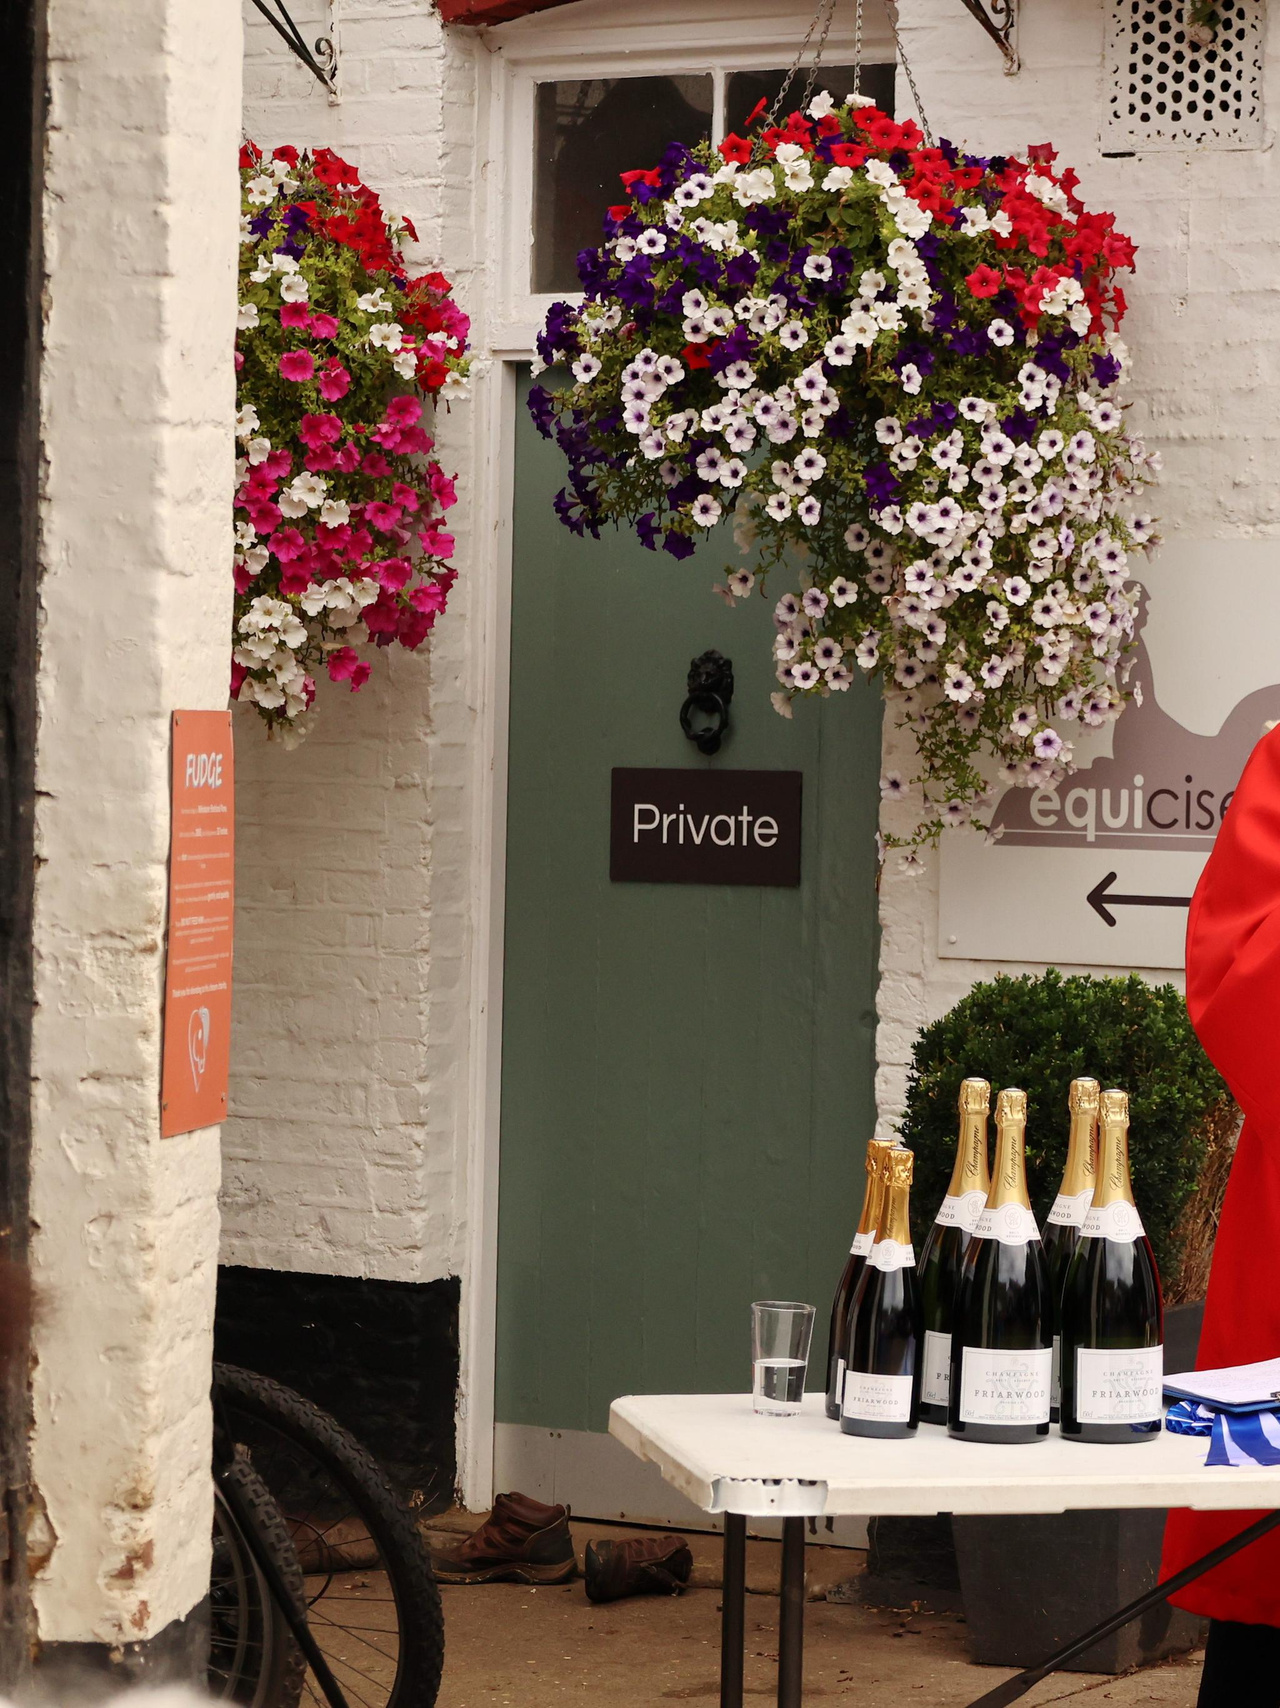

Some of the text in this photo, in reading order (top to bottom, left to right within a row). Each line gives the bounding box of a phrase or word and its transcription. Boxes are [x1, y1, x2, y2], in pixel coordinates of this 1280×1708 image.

[184, 751, 223, 789] FUDGE
[633, 803, 779, 848] Private
[965, 1124, 982, 1178] Champagne
[1004, 1135, 1021, 1190] Champagne
[1109, 1136, 1125, 1191] Champagne
[853, 1396, 899, 1406] FRIARWOOD
[974, 1389, 1046, 1399] FRIARWOOD
[1092, 1388, 1160, 1398] FRIARWOOD
